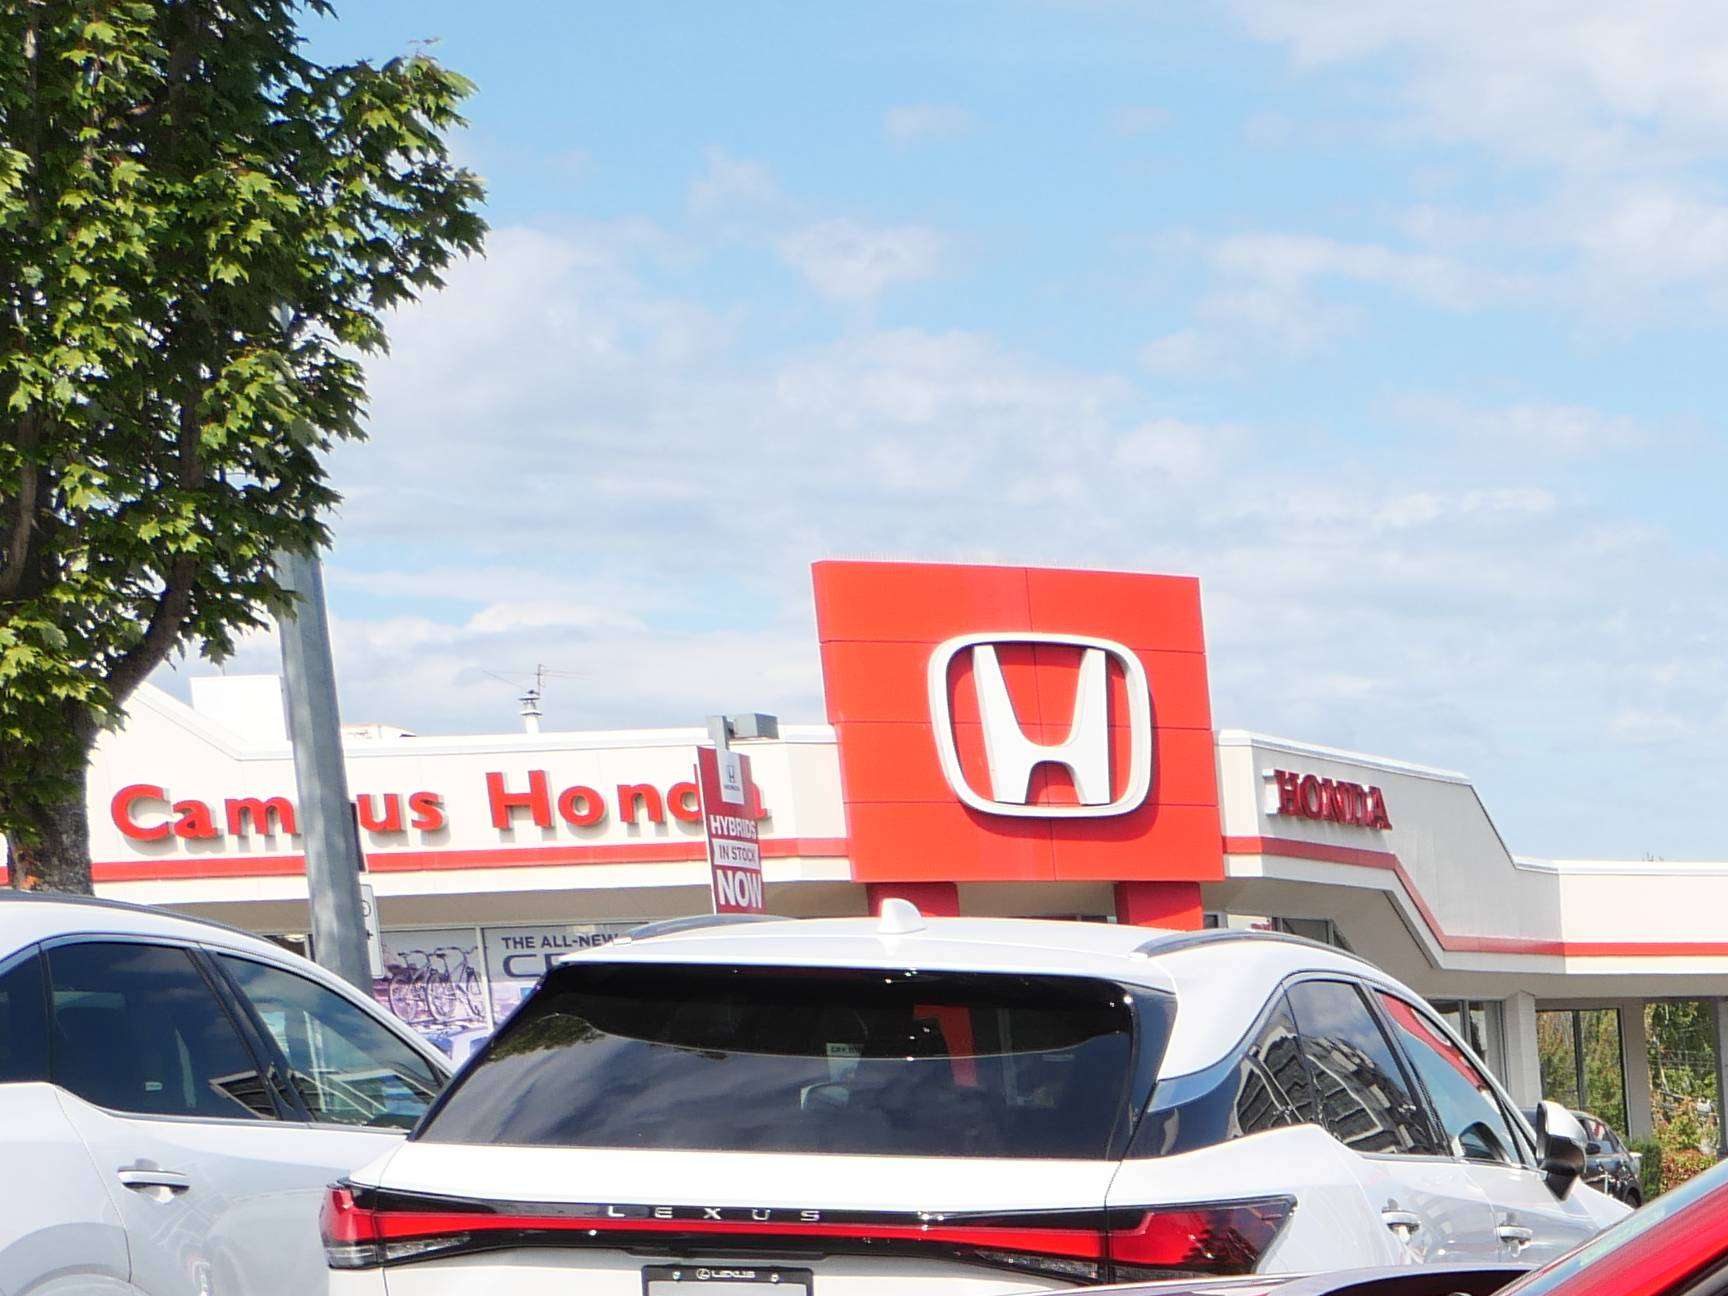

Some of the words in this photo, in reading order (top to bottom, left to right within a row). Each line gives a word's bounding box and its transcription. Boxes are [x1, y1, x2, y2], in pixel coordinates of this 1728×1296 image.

[1264, 769, 1392, 831] HONDA
[111, 784, 445, 841] Camus
[710, 814, 757, 840] HYBRIDS
[719, 844, 730, 861] IN
[732, 846, 756, 863] STOCK
[716, 869, 762, 909] NOW
[502, 936, 535, 949] THE
[541, 933, 619, 948] ALL-NEW
[608, 1206, 820, 1222] LEXUS
[711, 1270, 756, 1278] LEXUS
